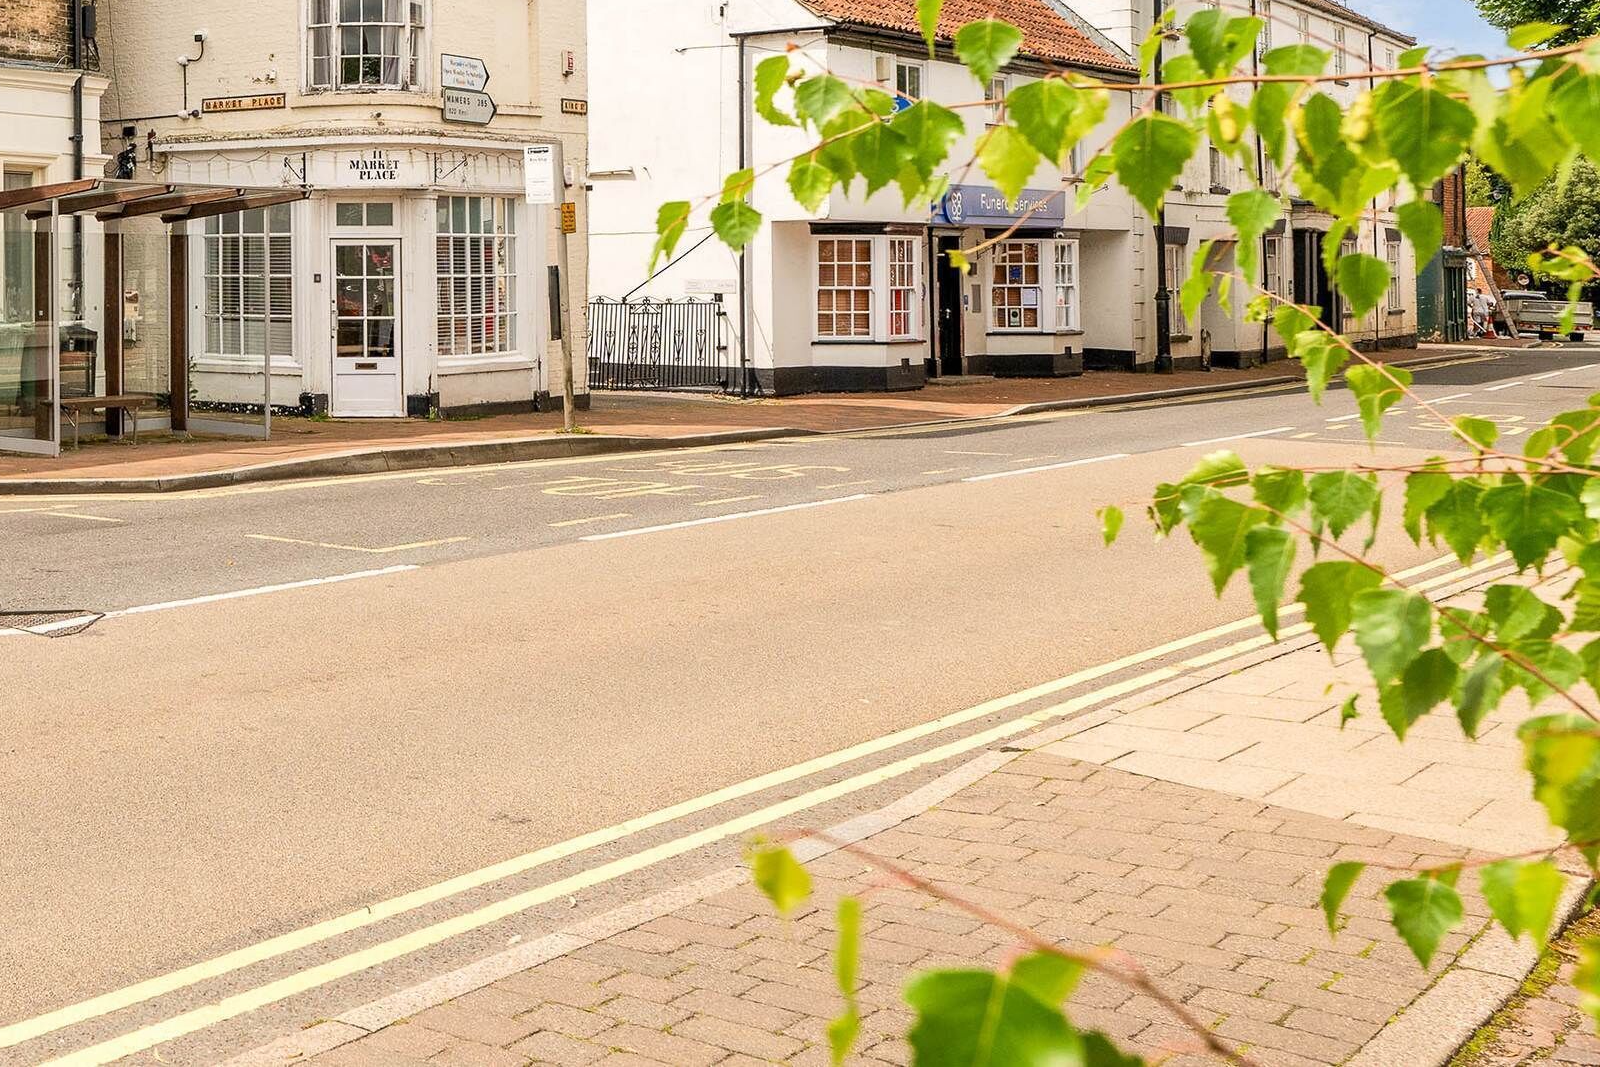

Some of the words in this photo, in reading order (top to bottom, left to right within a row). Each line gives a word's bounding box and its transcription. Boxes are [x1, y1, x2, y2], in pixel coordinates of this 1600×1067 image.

[204, 99, 243, 110] MARKET
[252, 96, 282, 107] PLACE
[349, 160, 400, 170] MARKET
[359, 170, 396, 180] PLACE
